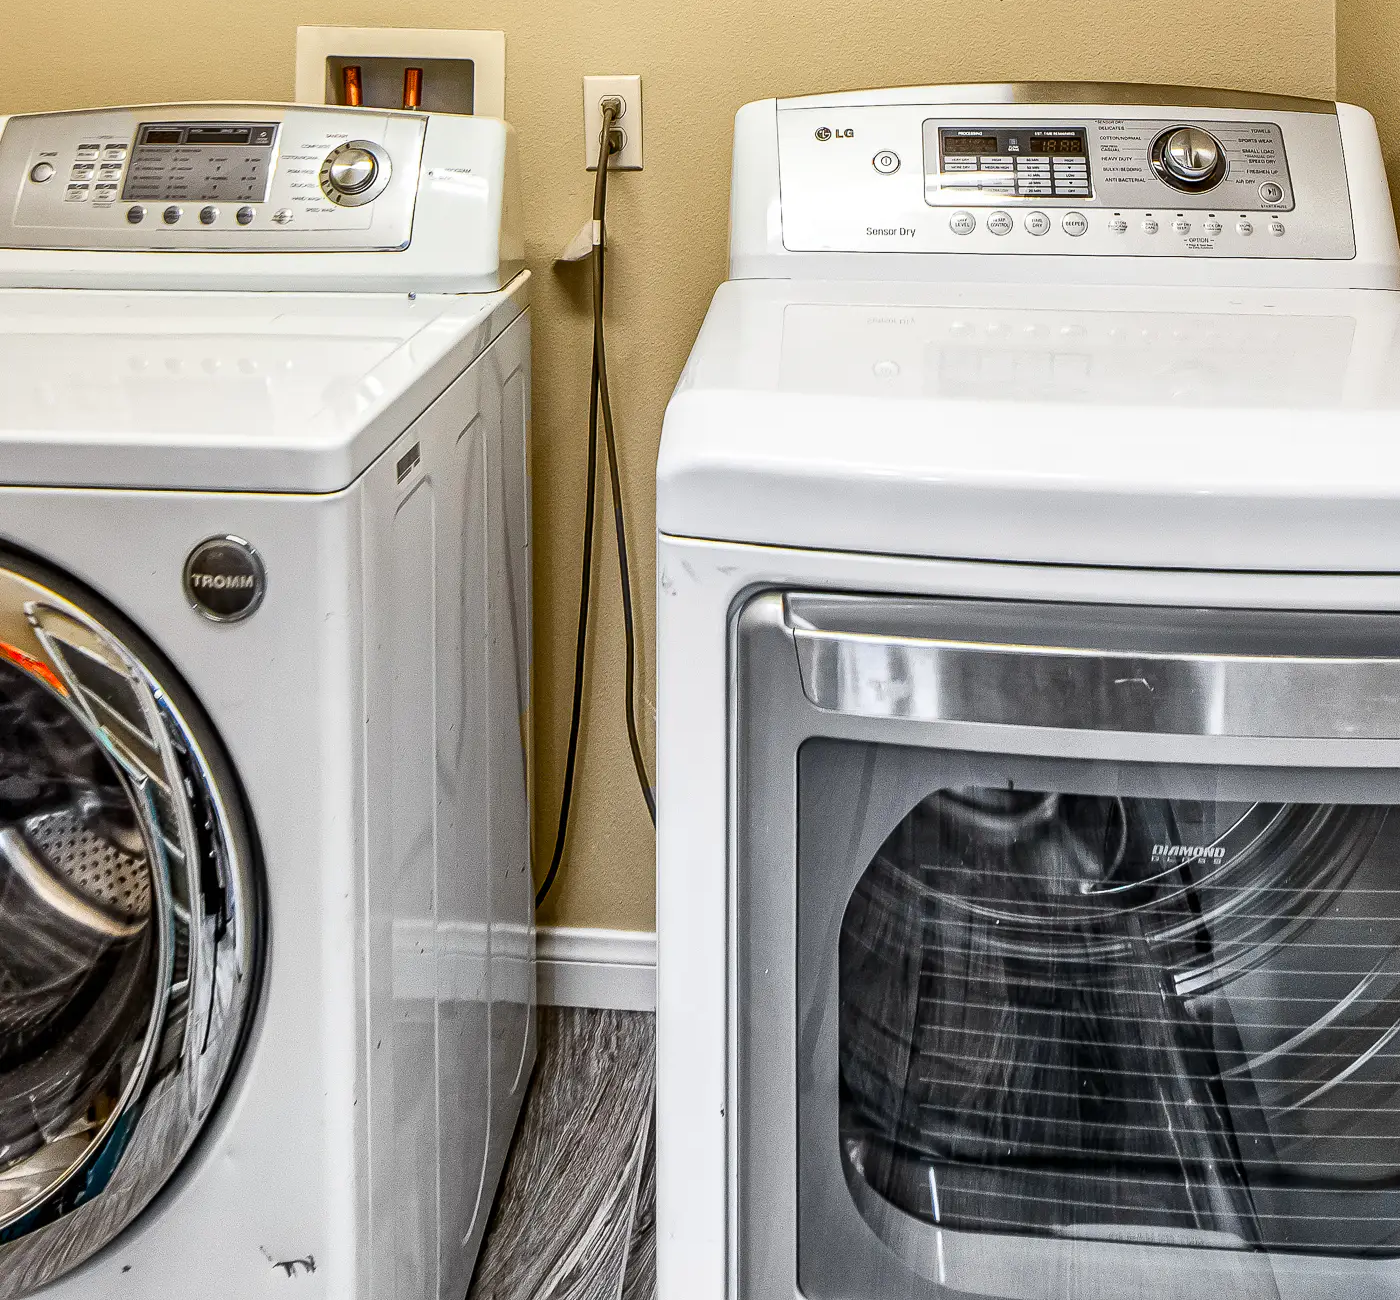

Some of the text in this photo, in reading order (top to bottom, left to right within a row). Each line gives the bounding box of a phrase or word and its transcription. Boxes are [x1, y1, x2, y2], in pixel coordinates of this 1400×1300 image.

[835, 128, 855, 139] LG
[866, 227, 916, 238] Sensor Dry
[191, 573, 254, 589] TROMM
[1152, 844, 1226, 858] DIAMOND
